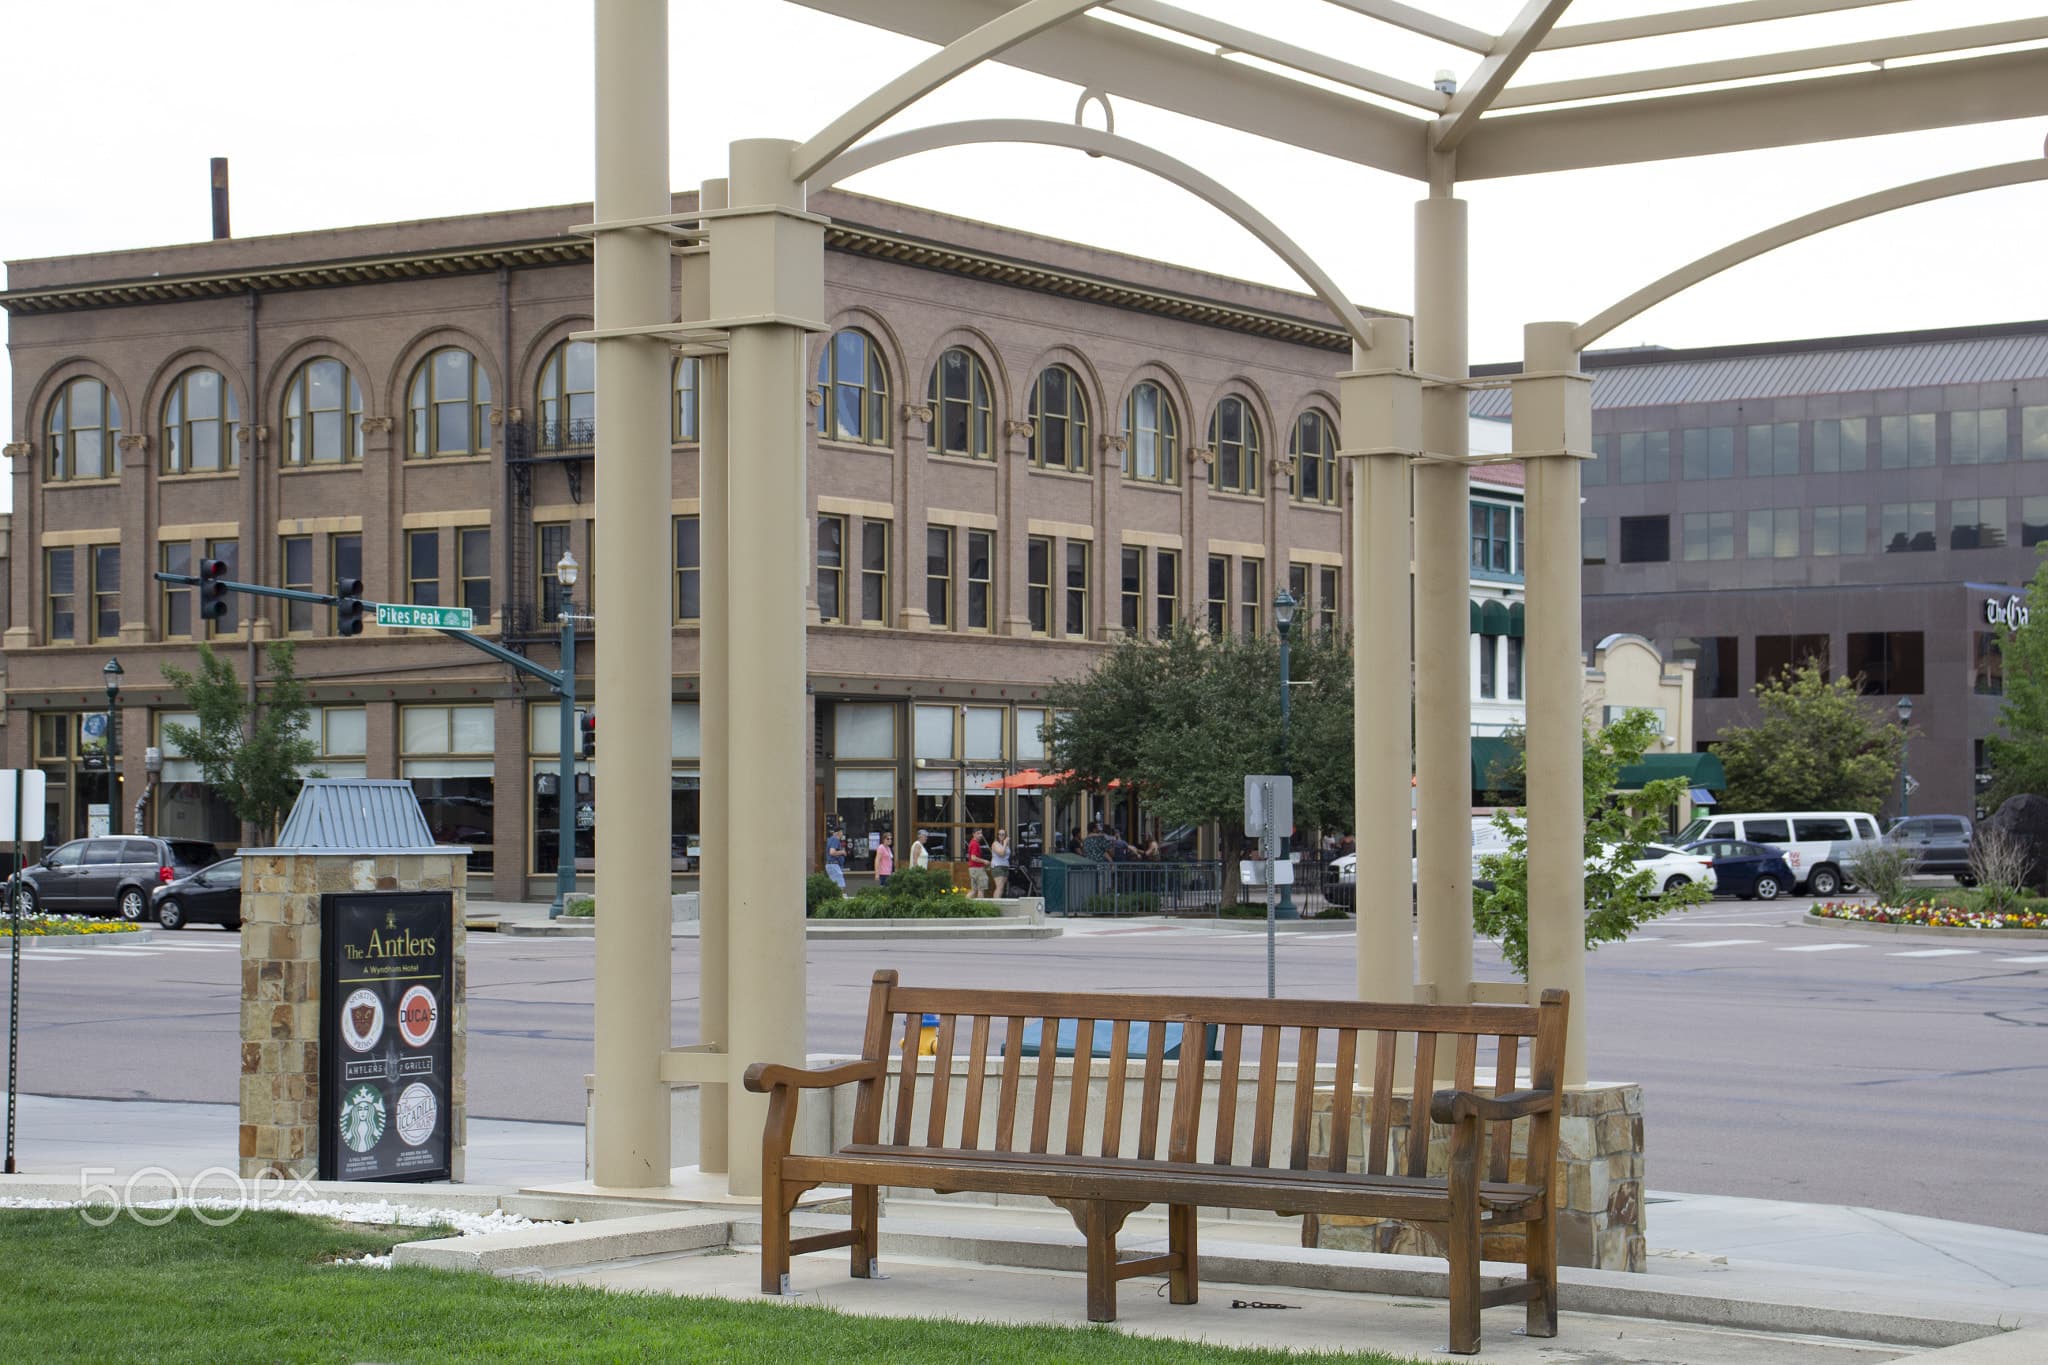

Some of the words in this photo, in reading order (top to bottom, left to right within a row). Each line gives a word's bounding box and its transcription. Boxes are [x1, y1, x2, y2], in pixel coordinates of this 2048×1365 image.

[379, 607, 410, 624] Pikes
[413, 609, 440, 625] Peak
[1987, 598, 2006, 624] The
[344, 944, 364, 960] The
[365, 928, 436, 959] Antlers
[370, 965, 402, 975] Wyndham
[402, 963, 419, 972] Hotel
[400, 1007, 437, 1023] DUCA'S
[354, 1038, 374, 1049] PRIMO
[348, 1064, 383, 1075] ANTLERS
[404, 1060, 431, 1071] GRILLE
